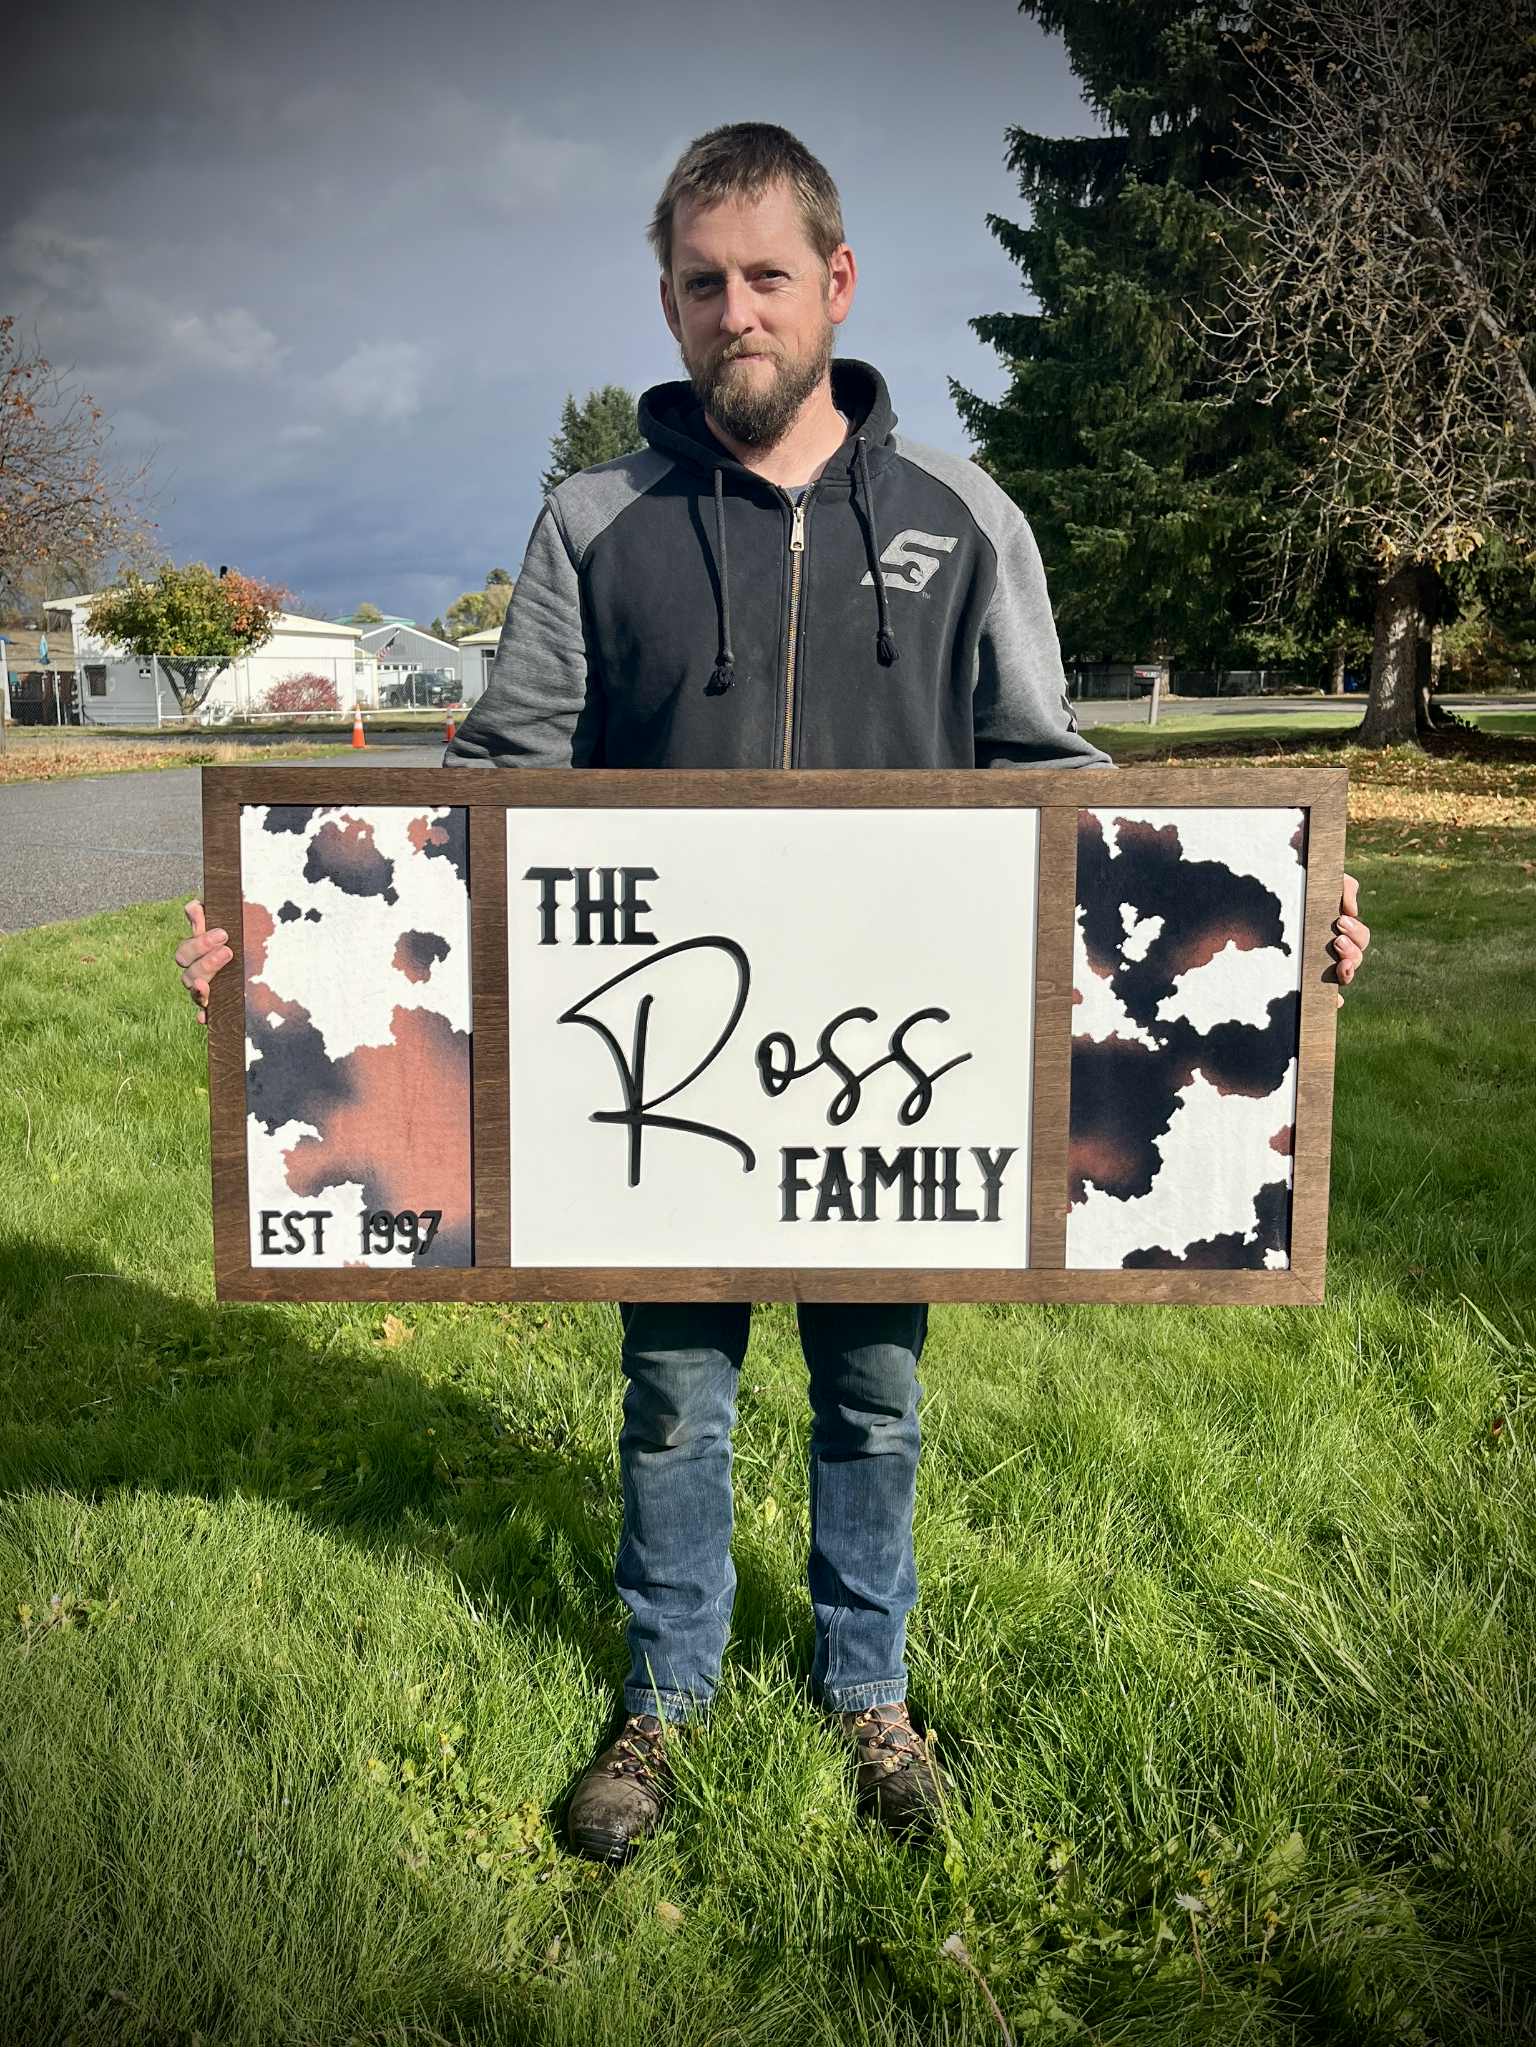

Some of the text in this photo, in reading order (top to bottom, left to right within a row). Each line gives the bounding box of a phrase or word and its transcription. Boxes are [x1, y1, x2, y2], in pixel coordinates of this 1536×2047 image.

[522, 866, 659, 945] THE
[556, 935, 974, 1187] Ross
[777, 1146, 1020, 1222] FAMILY
[259, 1209, 443, 1255] EST 1997
